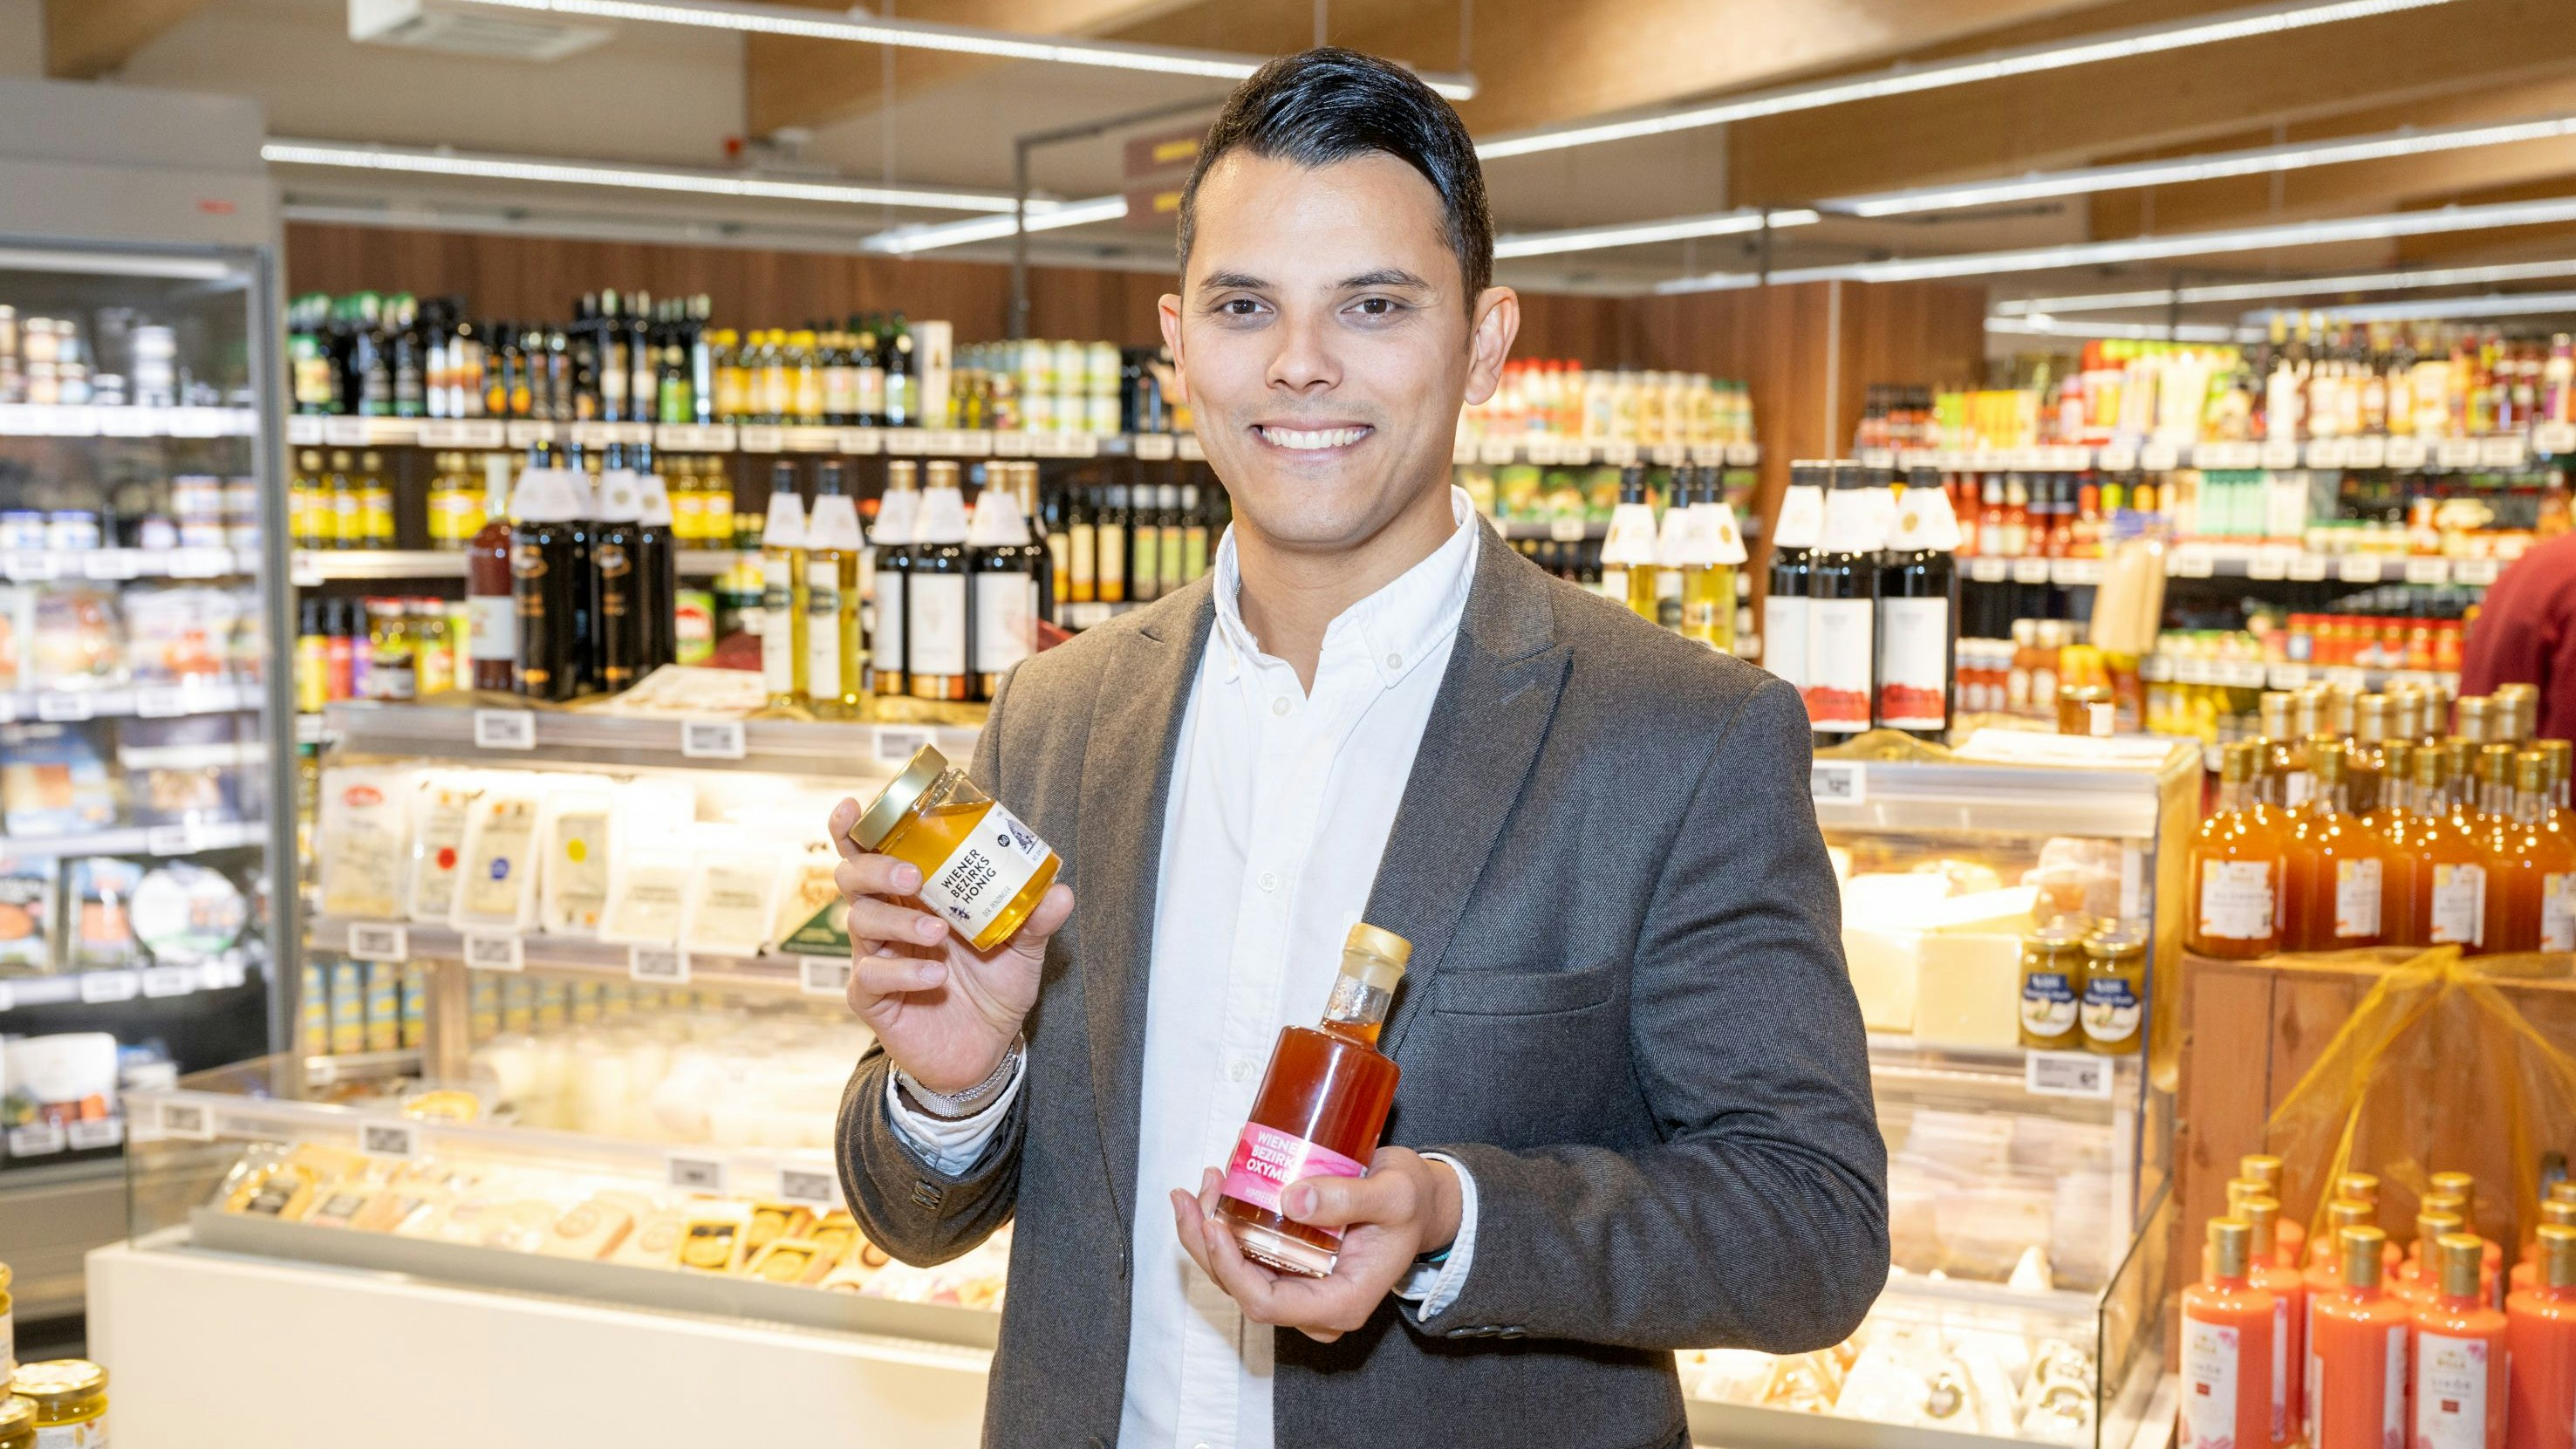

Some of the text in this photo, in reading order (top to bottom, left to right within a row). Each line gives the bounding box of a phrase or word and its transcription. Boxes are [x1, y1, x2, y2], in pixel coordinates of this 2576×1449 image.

[941, 849, 981, 889] WIENER
[951, 856, 989, 899] BEZIRKS
[961, 867, 996, 905] HONIG
[1251, 1144, 1296, 1171] BEZIRK
[1257, 1130, 1301, 1155] WIENE
[1246, 1158, 1292, 1181] OXYME
